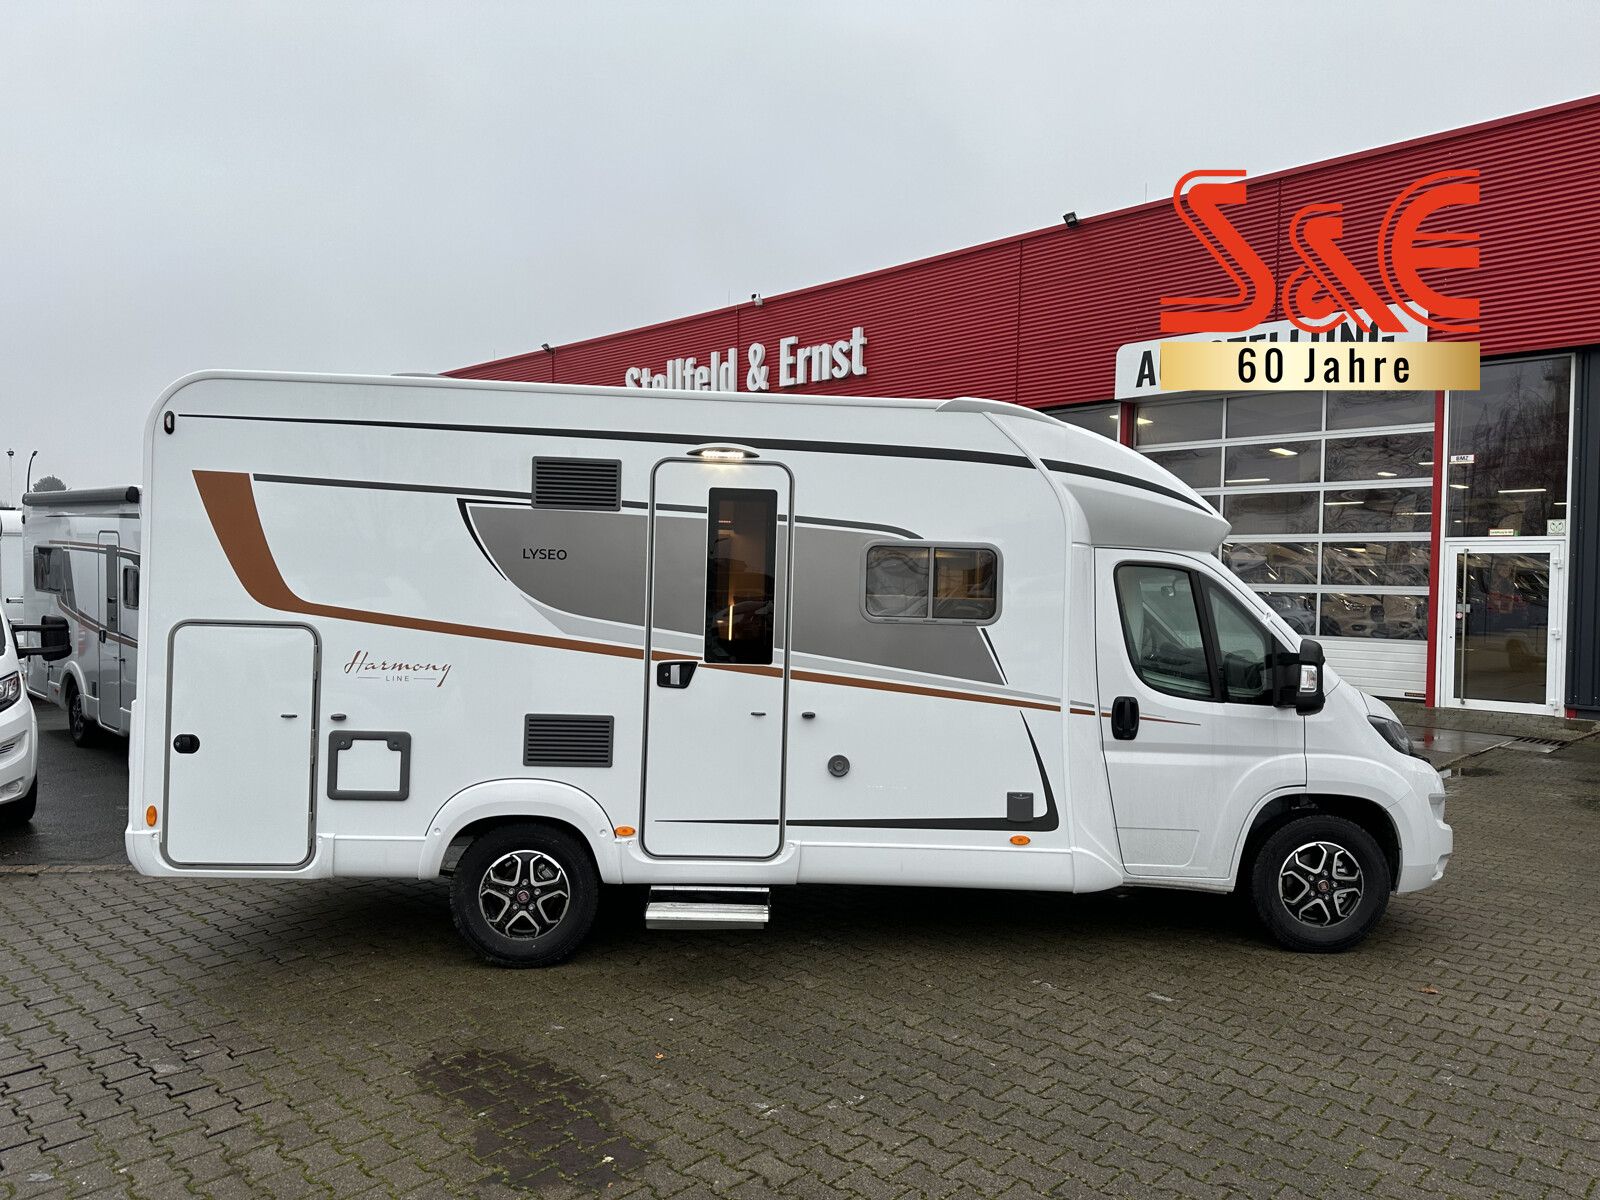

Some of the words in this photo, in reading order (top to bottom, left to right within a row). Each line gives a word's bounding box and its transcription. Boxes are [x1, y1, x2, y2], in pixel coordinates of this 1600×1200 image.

[746, 342, 769, 392] &
[779, 326, 868, 387] Ernst
[522, 548, 568, 561] LYSEO
[343, 650, 452, 688] Harmony
